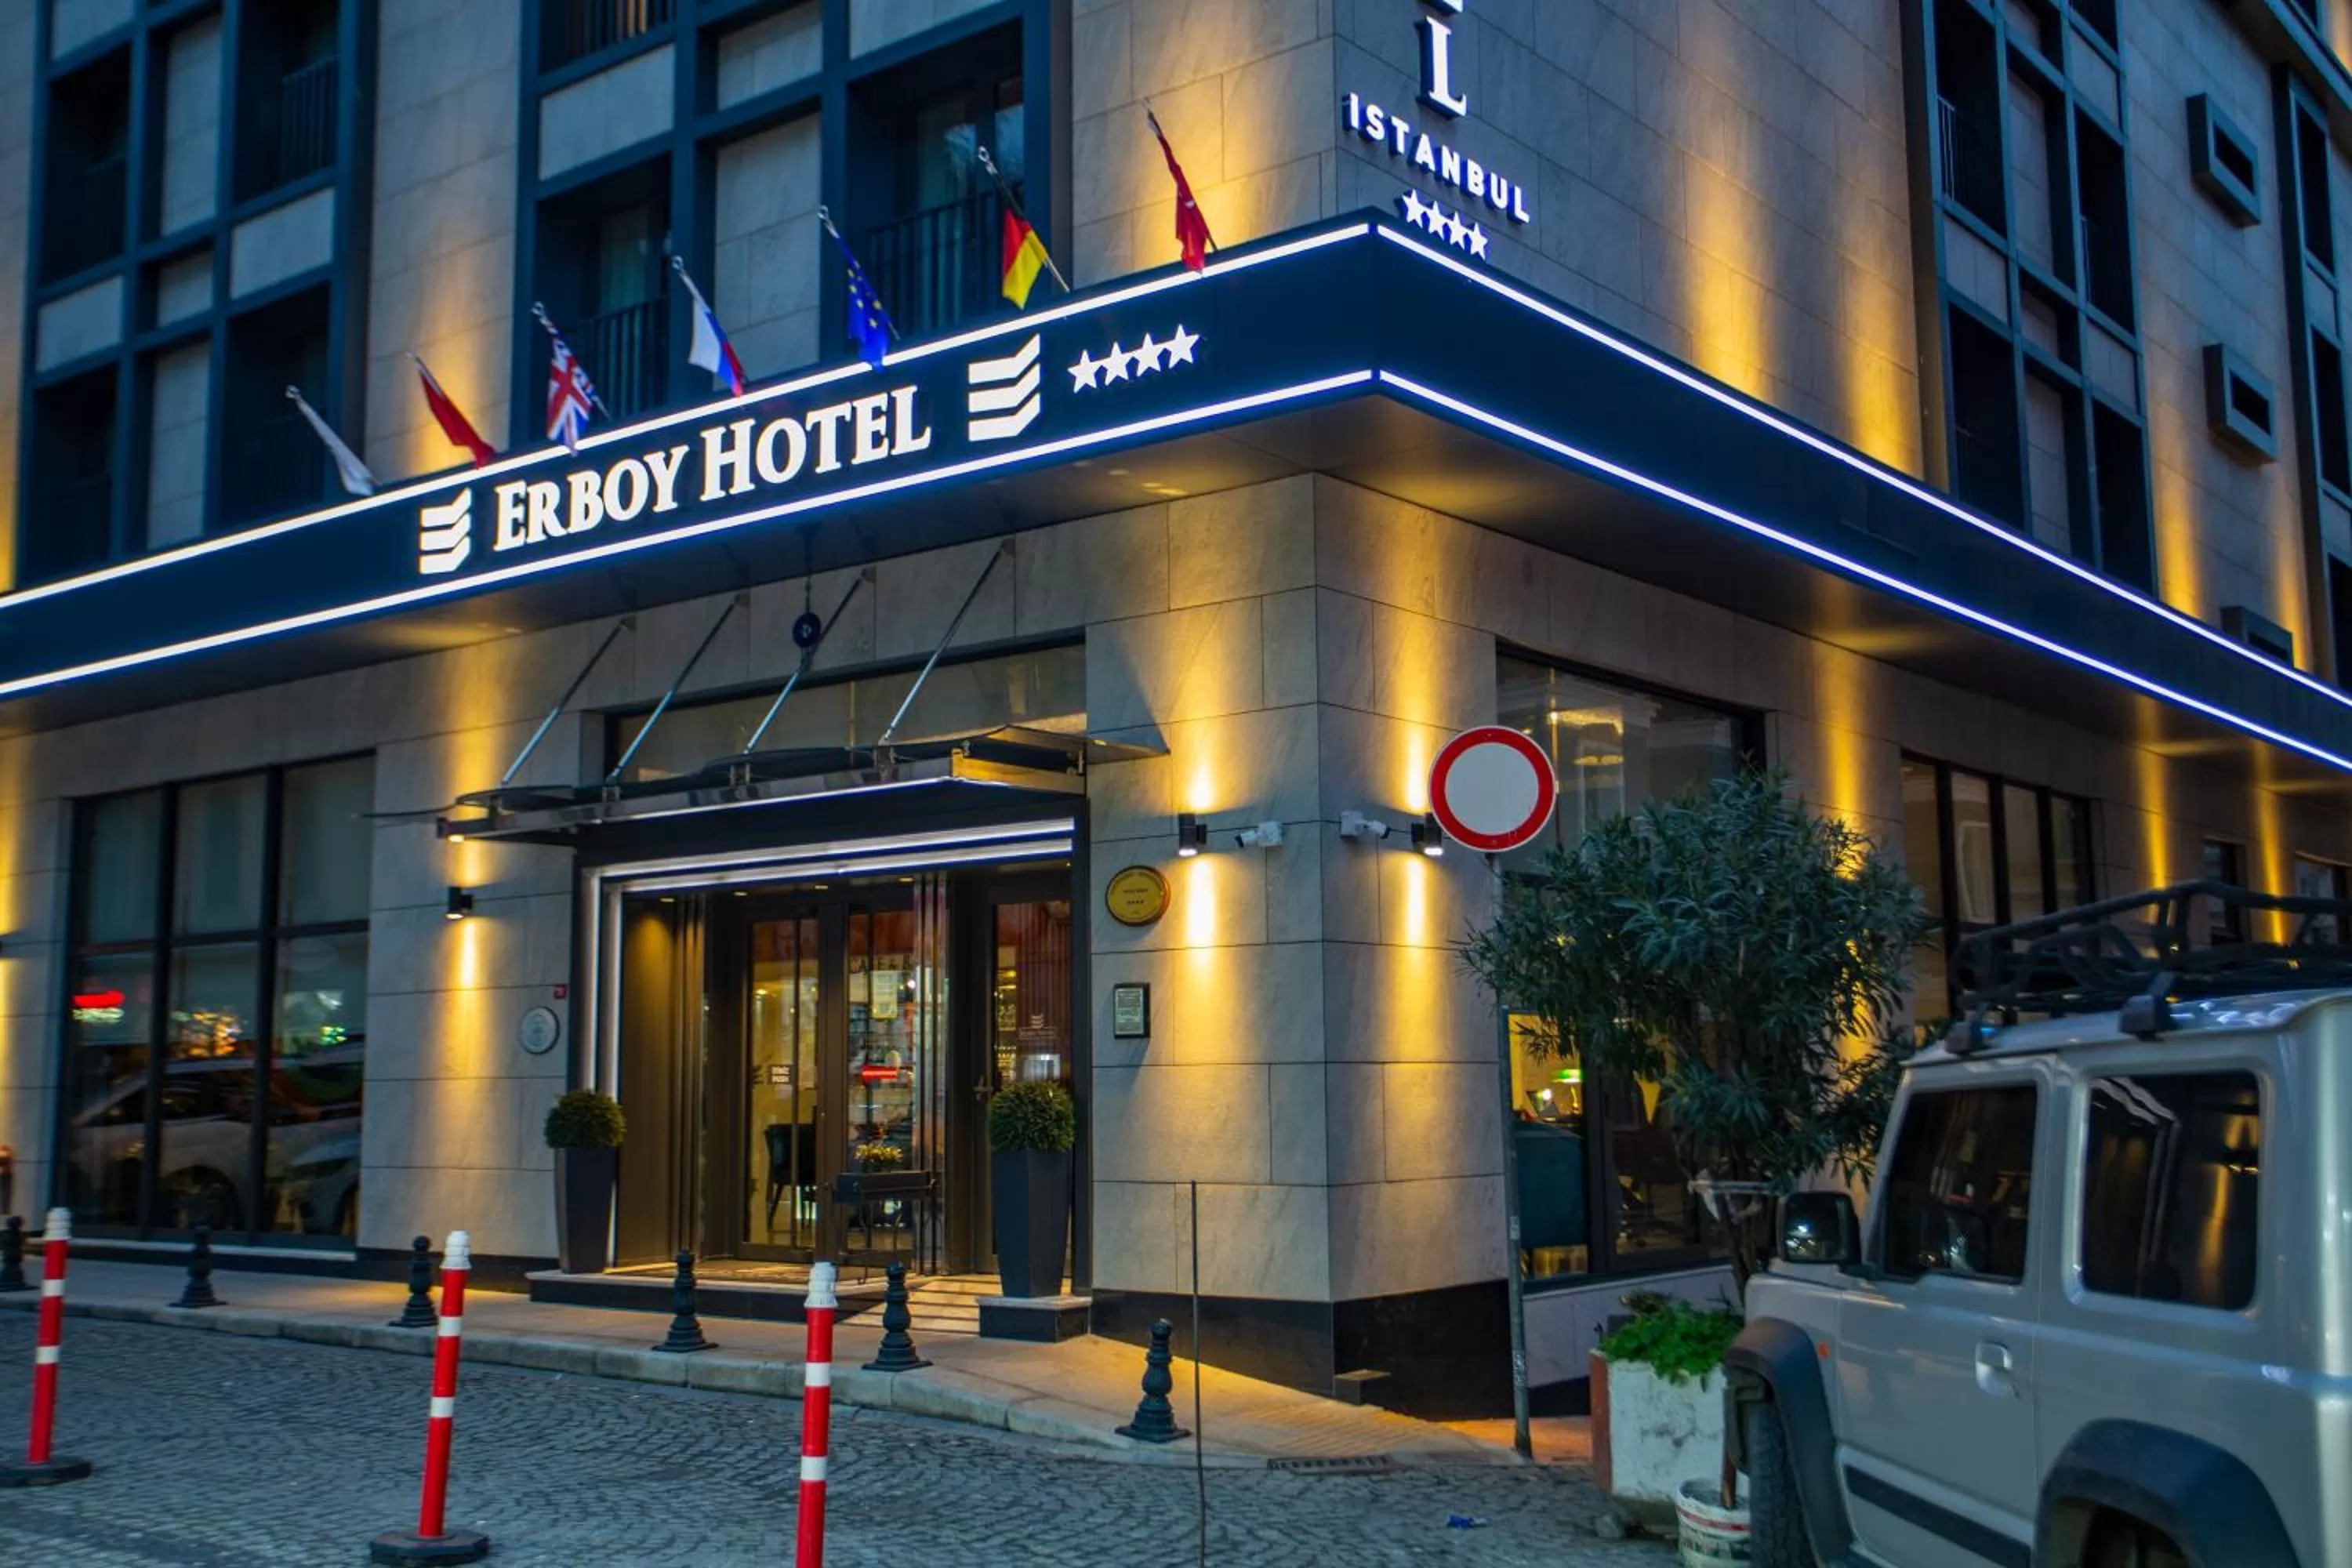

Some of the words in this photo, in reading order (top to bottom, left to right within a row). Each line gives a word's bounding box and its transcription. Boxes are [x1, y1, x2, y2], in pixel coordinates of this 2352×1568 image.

[1348, 92, 1530, 223] ISTANBUL
[493, 445, 689, 552] ERBOY
[699, 385, 931, 502] HOTEL
